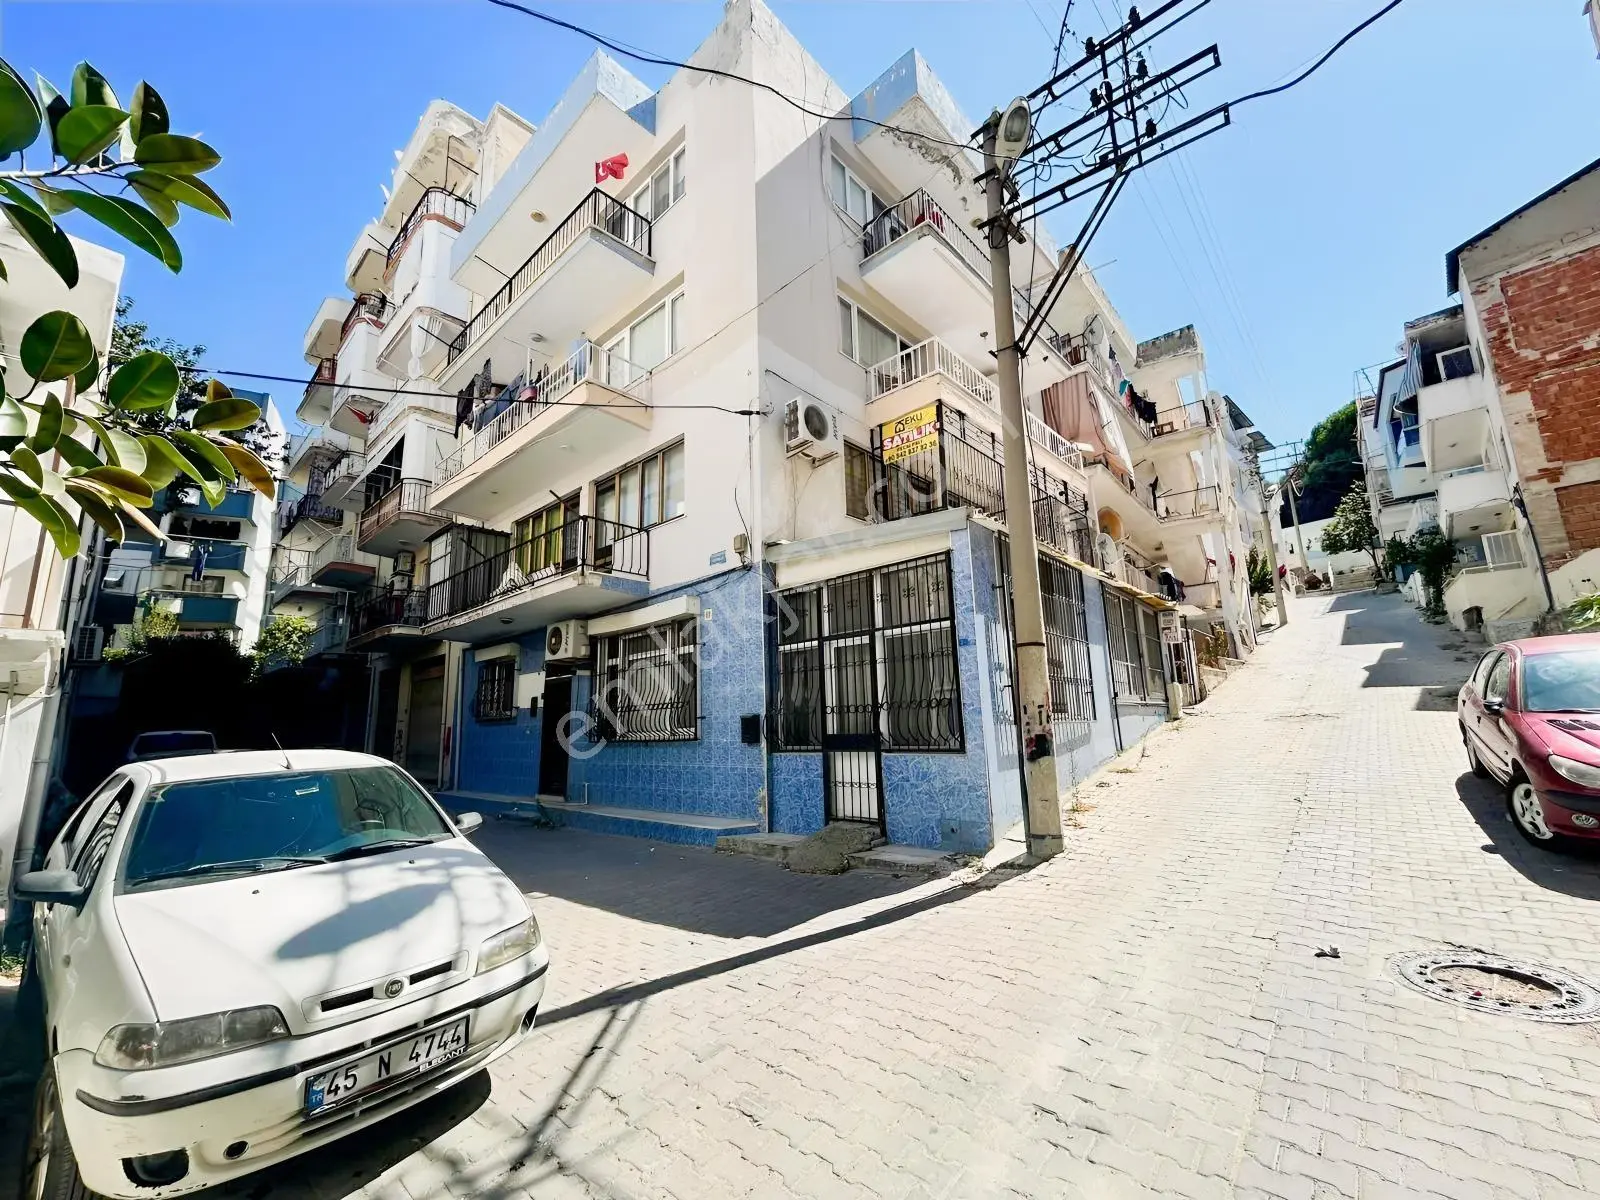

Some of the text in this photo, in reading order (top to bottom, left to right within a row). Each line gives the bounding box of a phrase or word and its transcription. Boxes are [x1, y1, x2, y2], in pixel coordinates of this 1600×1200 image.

[882, 423, 937, 450] SATILIK
[326, 1024, 462, 1097] 45 N 4744
[419, 1044, 467, 1072] ELEGANT
[311, 1092, 323, 1103] TR
